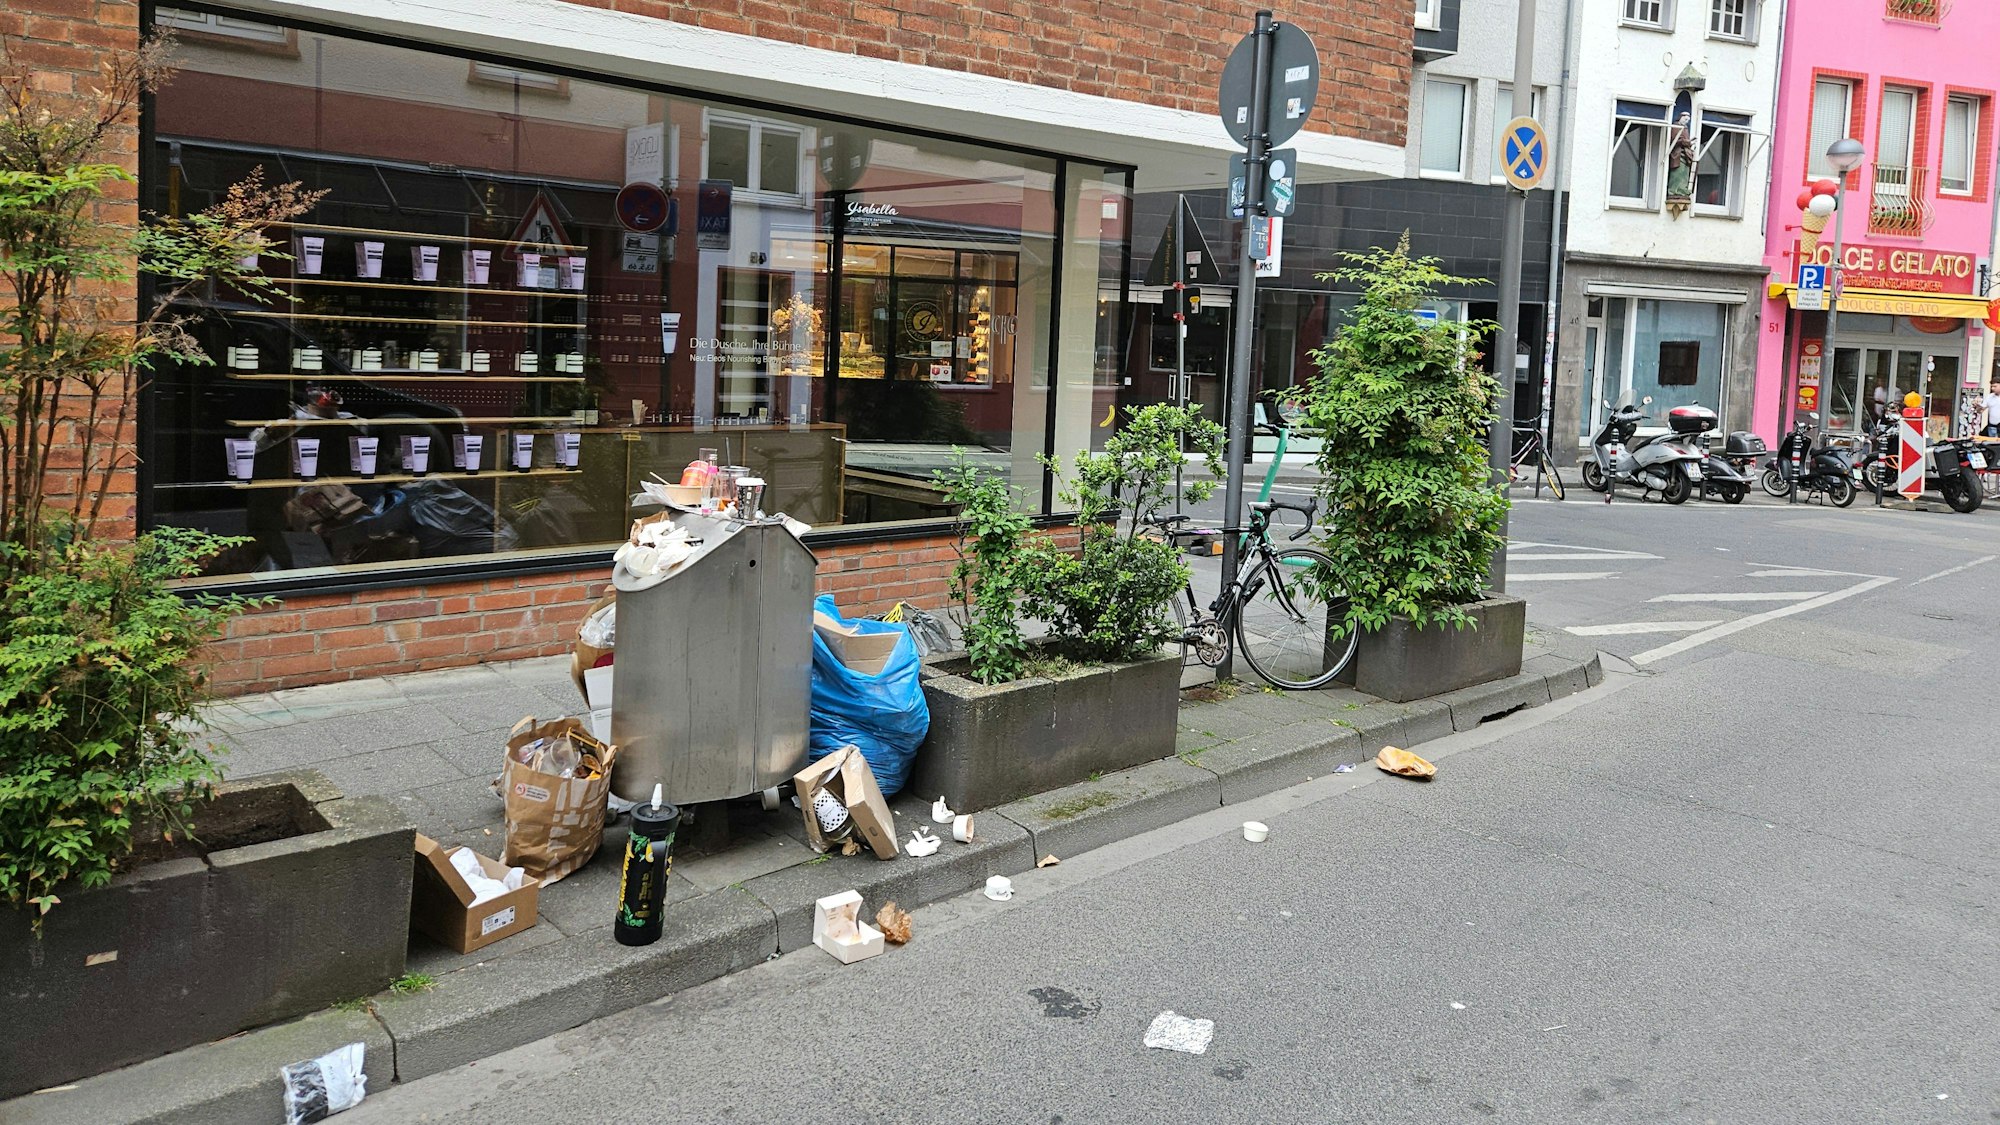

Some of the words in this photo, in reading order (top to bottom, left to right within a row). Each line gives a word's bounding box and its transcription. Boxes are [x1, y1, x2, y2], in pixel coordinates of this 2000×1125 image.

[844, 201, 899, 216] Isabella
[1877, 259, 1887, 272] &
[1890, 250, 1971, 279] GELATO
[1802, 267, 1818, 289] P
[1841, 300, 1880, 313] DOLCE
[1884, 302, 1892, 313] &
[1895, 303, 1940, 315] GELATO
[1769, 322, 1779, 333] 51
[689, 338, 708, 349] Die
[710, 338, 749, 351] Dusche,
[752, 339, 768, 351] Ihre
[689, 353, 706, 362] Neu:
[727, 355, 762, 365] Nourishing
